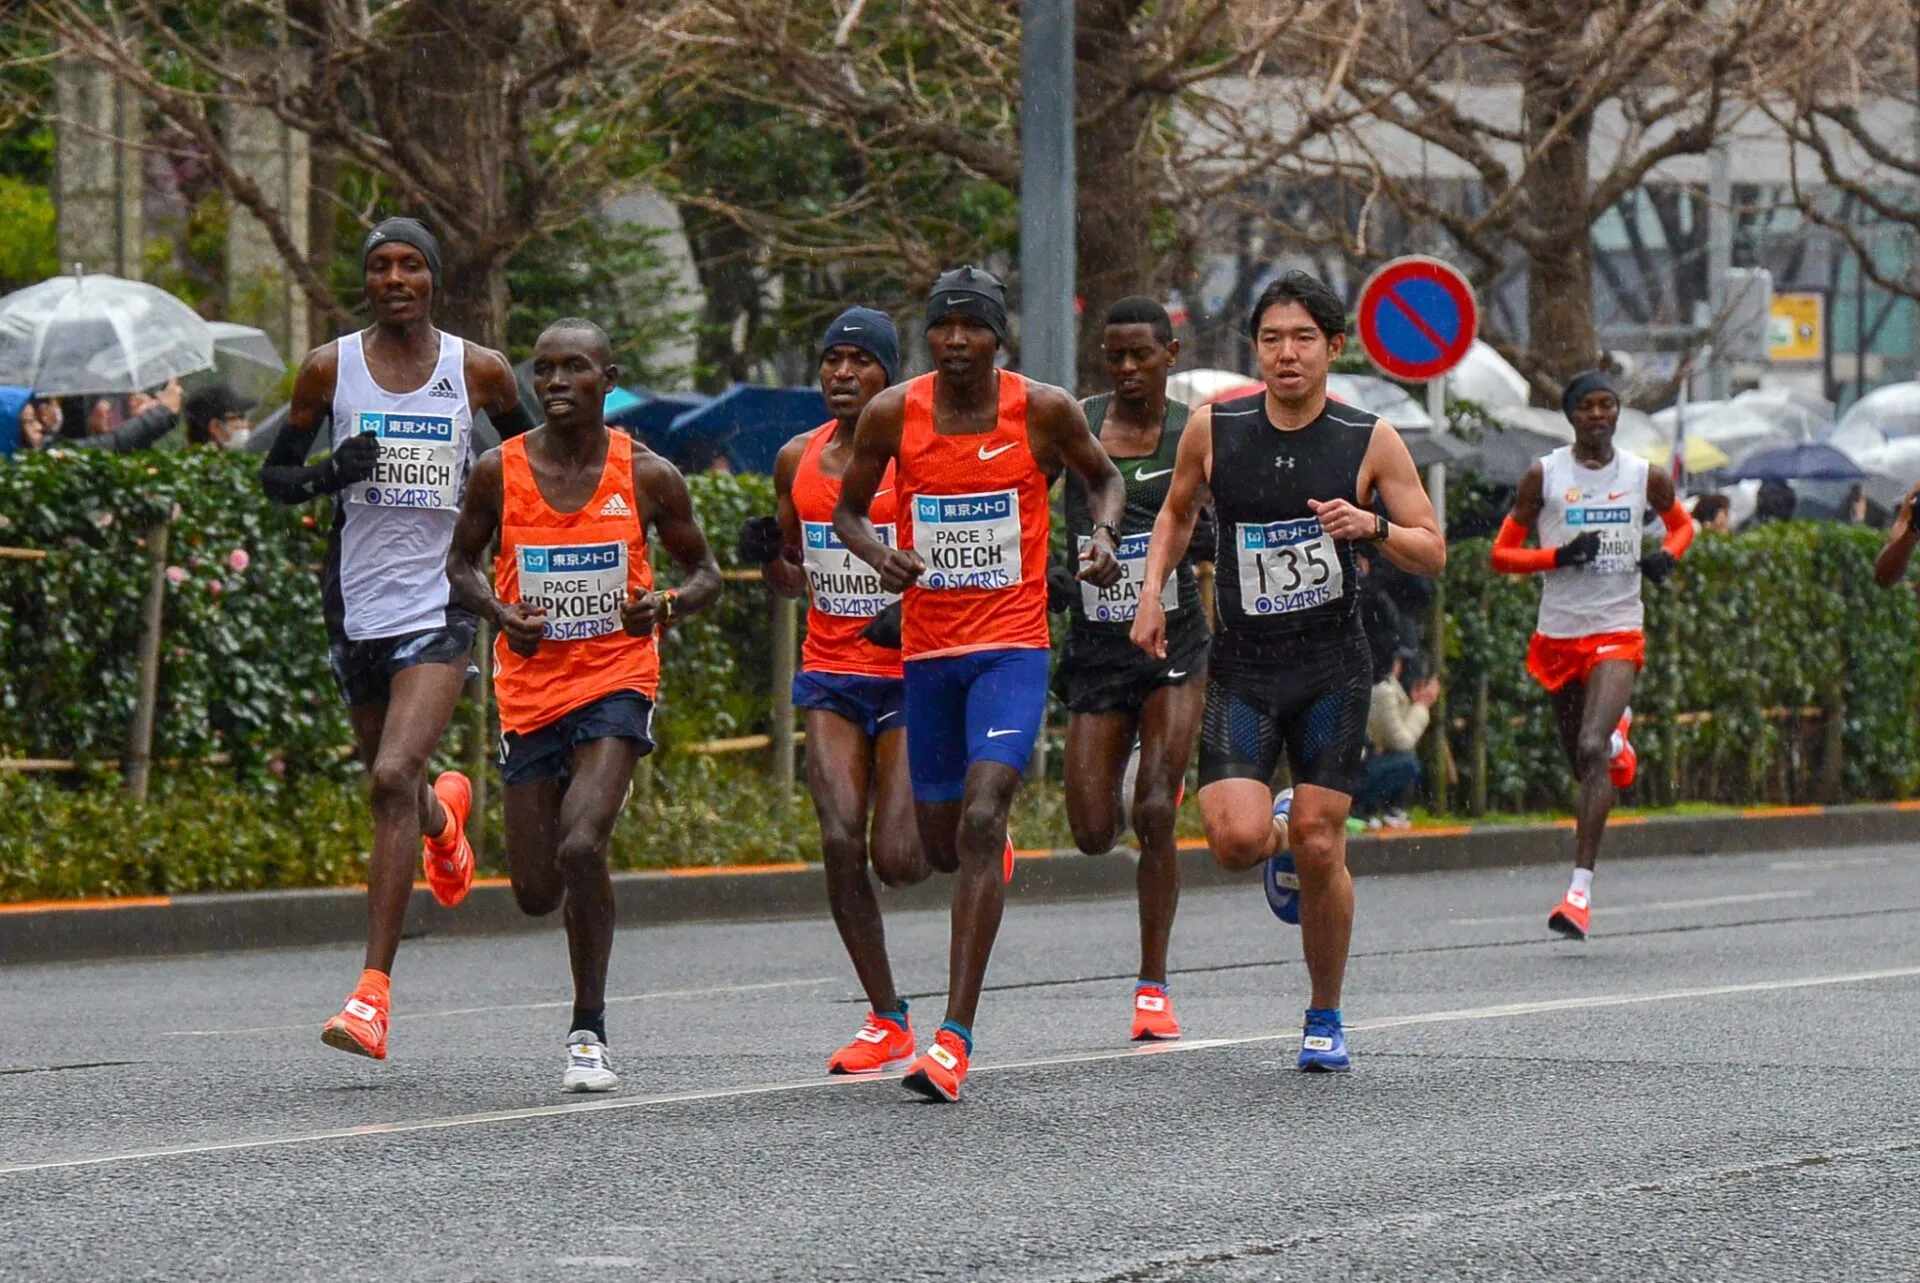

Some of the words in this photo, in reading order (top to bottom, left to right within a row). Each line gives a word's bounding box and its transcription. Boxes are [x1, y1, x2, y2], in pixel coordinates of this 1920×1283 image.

[428, 390, 459, 400] adidas
[388, 420, 449, 435] 東京メトロ
[379, 446, 420, 460] PACE
[427, 448, 435, 461] 2
[366, 462, 450, 486] ENGICH
[384, 487, 442, 508] STARTS
[600, 508, 632, 516] adidas
[944, 500, 1007, 517] 東京メトロ
[936, 530, 980, 544] PACE
[986, 528, 995, 542] 3
[1267, 524, 1319, 543] 東京メトロ
[552, 551, 615, 567] 東京メトロ
[843, 553, 851, 570] 4
[931, 544, 1002, 569] KOECH
[1256, 542, 1329, 594] 135
[543, 580, 588, 594] PACE
[810, 571, 884, 594] CHUMB
[1274, 585, 1331, 612] STARTS
[554, 617, 615, 639] STARTS
